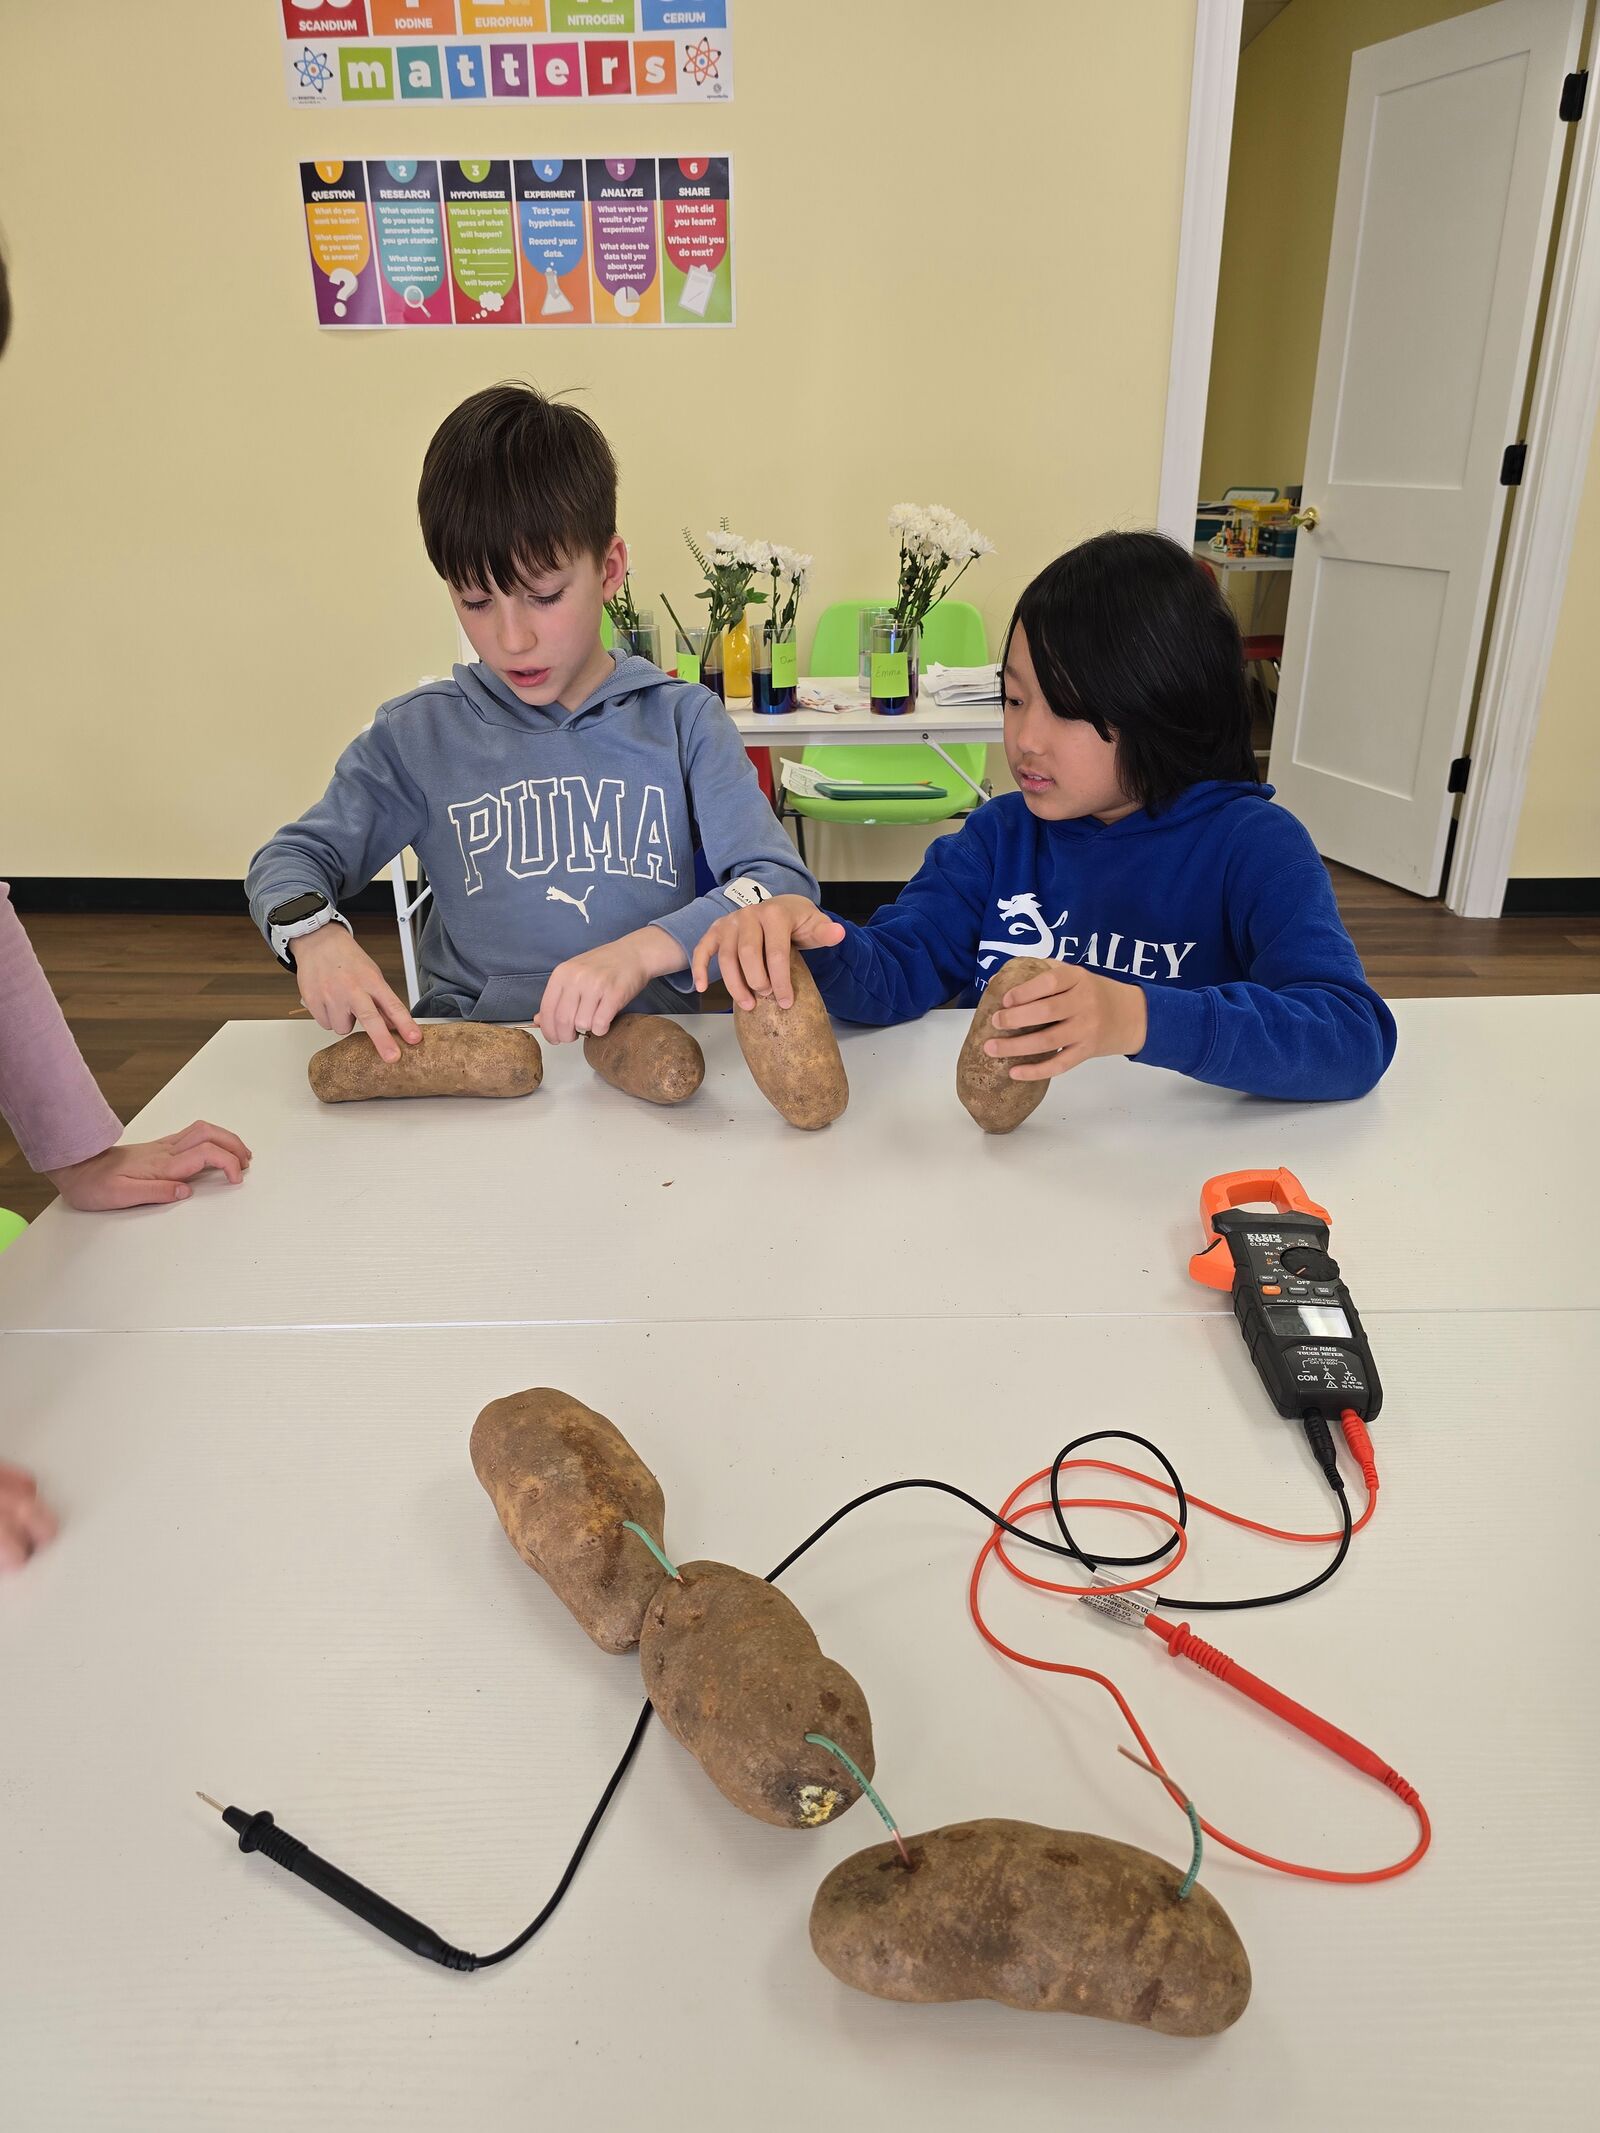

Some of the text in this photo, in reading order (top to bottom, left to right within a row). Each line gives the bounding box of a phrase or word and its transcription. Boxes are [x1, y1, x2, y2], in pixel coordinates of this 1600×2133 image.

[475, 16, 533, 27] EUROPIUM
[568, 14, 624, 26] NITROGEN
[663, 12, 706, 24] CERIUM
[299, 20, 357, 31] SCANDIUM
[395, 18, 432, 29] IODINE
[347, 53, 666, 88] matters
[326, 166, 332, 177] 1
[398, 165, 407, 176] 2
[472, 165, 480, 176] 3
[544, 164, 553, 176] 4
[617, 164, 625, 175] 5
[690, 162, 698, 174] 6
[312, 190, 356, 201] QUESTION
[380, 190, 430, 199] RESEARCH
[450, 191, 505, 199] HYPOTHESIZE
[524, 190, 575, 199] EXPERIMENT
[600, 188, 644, 197] ANALYZE
[679, 187, 710, 196] SHARE
[532, 206, 570, 216] Test your
[676, 204, 714, 213] What did
[528, 219, 575, 229] hypothesis.
[674, 218, 717, 228] you learn?
[474, 231, 502, 239] happen?
[603, 226, 645, 234] experiment?
[528, 237, 578, 247] Record your
[667, 236, 724, 245] What will you
[544, 250, 564, 258] data.
[679, 249, 714, 257] do next?
[606, 273, 646, 281] hypothesis?
[447, 776, 678, 896] PUMA
